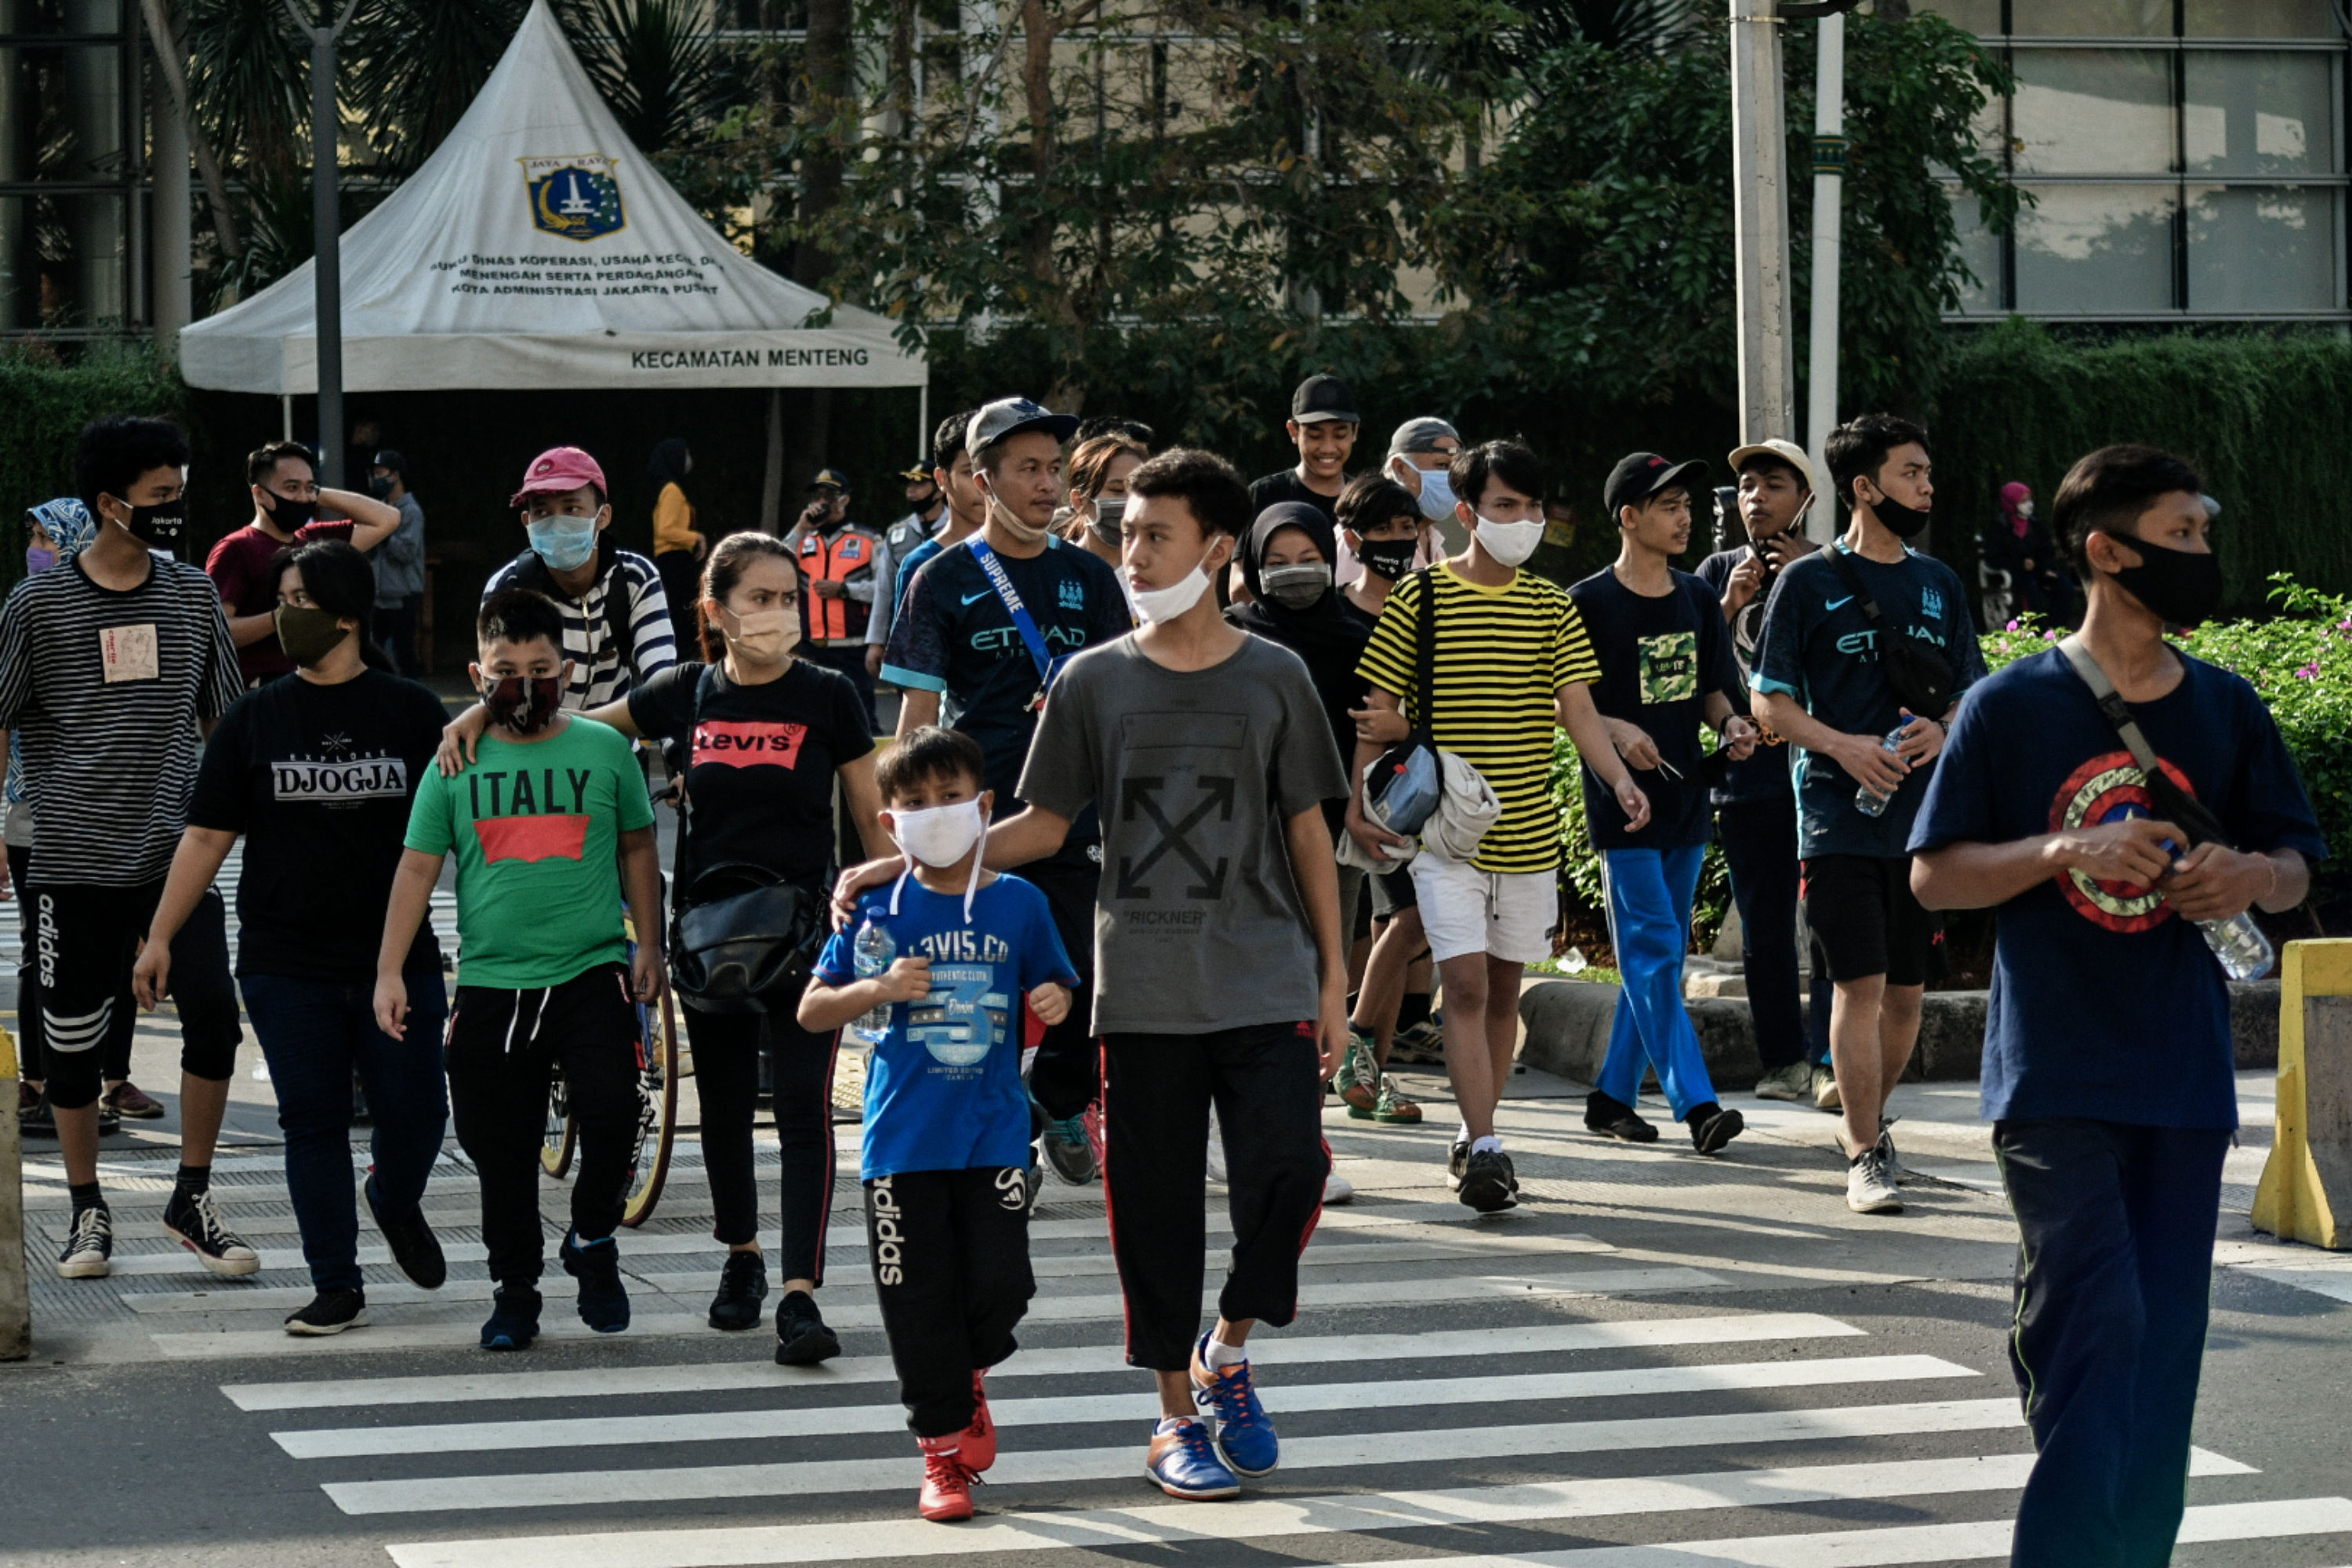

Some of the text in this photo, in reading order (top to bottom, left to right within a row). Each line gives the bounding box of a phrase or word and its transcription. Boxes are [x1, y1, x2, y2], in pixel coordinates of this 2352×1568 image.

[472, 255, 515, 266] DINAS
[519, 255, 598, 267] KOPERASI,
[601, 255, 652, 266] USAHA
[459, 269, 704, 281] MENENGAH SERTA PERDAGANGAN
[451, 282, 718, 296] KOTA ADMINISTRASI JAKARTA PUSAT
[632, 349, 869, 368] KECAMATAN MENTENG
[980, 551, 1024, 613] SUPREME
[971, 624, 1086, 651] ETAD
[289, 749, 387, 763] EXPLORE
[277, 764, 404, 793] DJOGJA
[470, 768, 591, 819] ITALY
[38, 894, 59, 988] adidas
